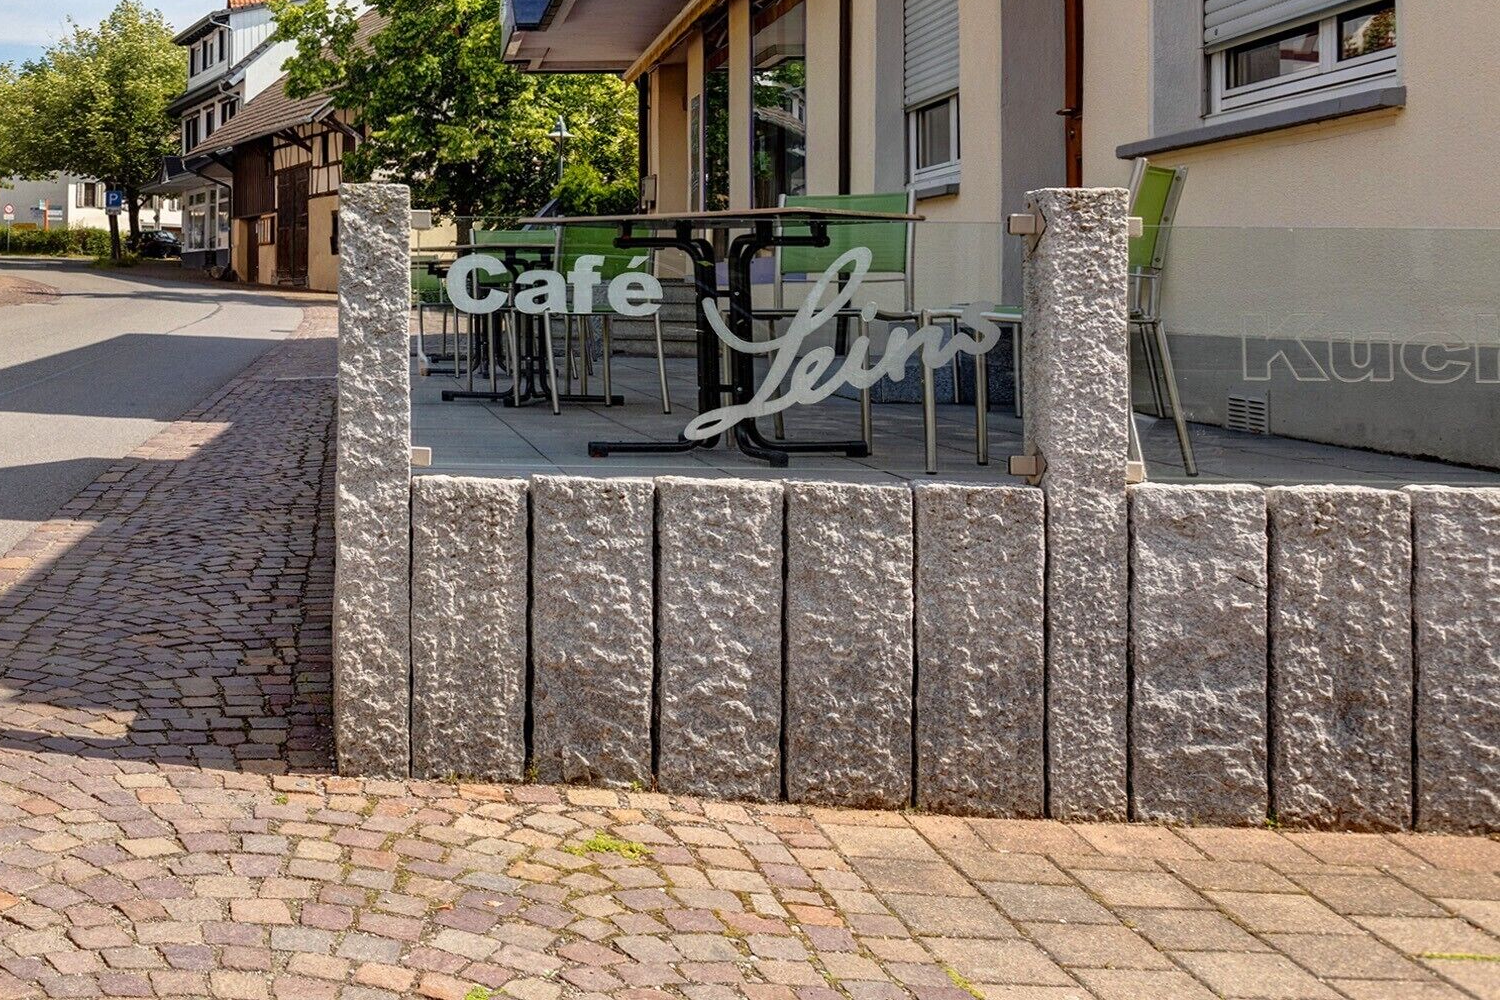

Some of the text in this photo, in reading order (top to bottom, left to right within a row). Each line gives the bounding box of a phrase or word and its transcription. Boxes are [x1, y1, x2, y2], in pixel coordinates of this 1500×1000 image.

[108, 193, 118, 205] P
[446, 246, 1001, 441] Café Leins
